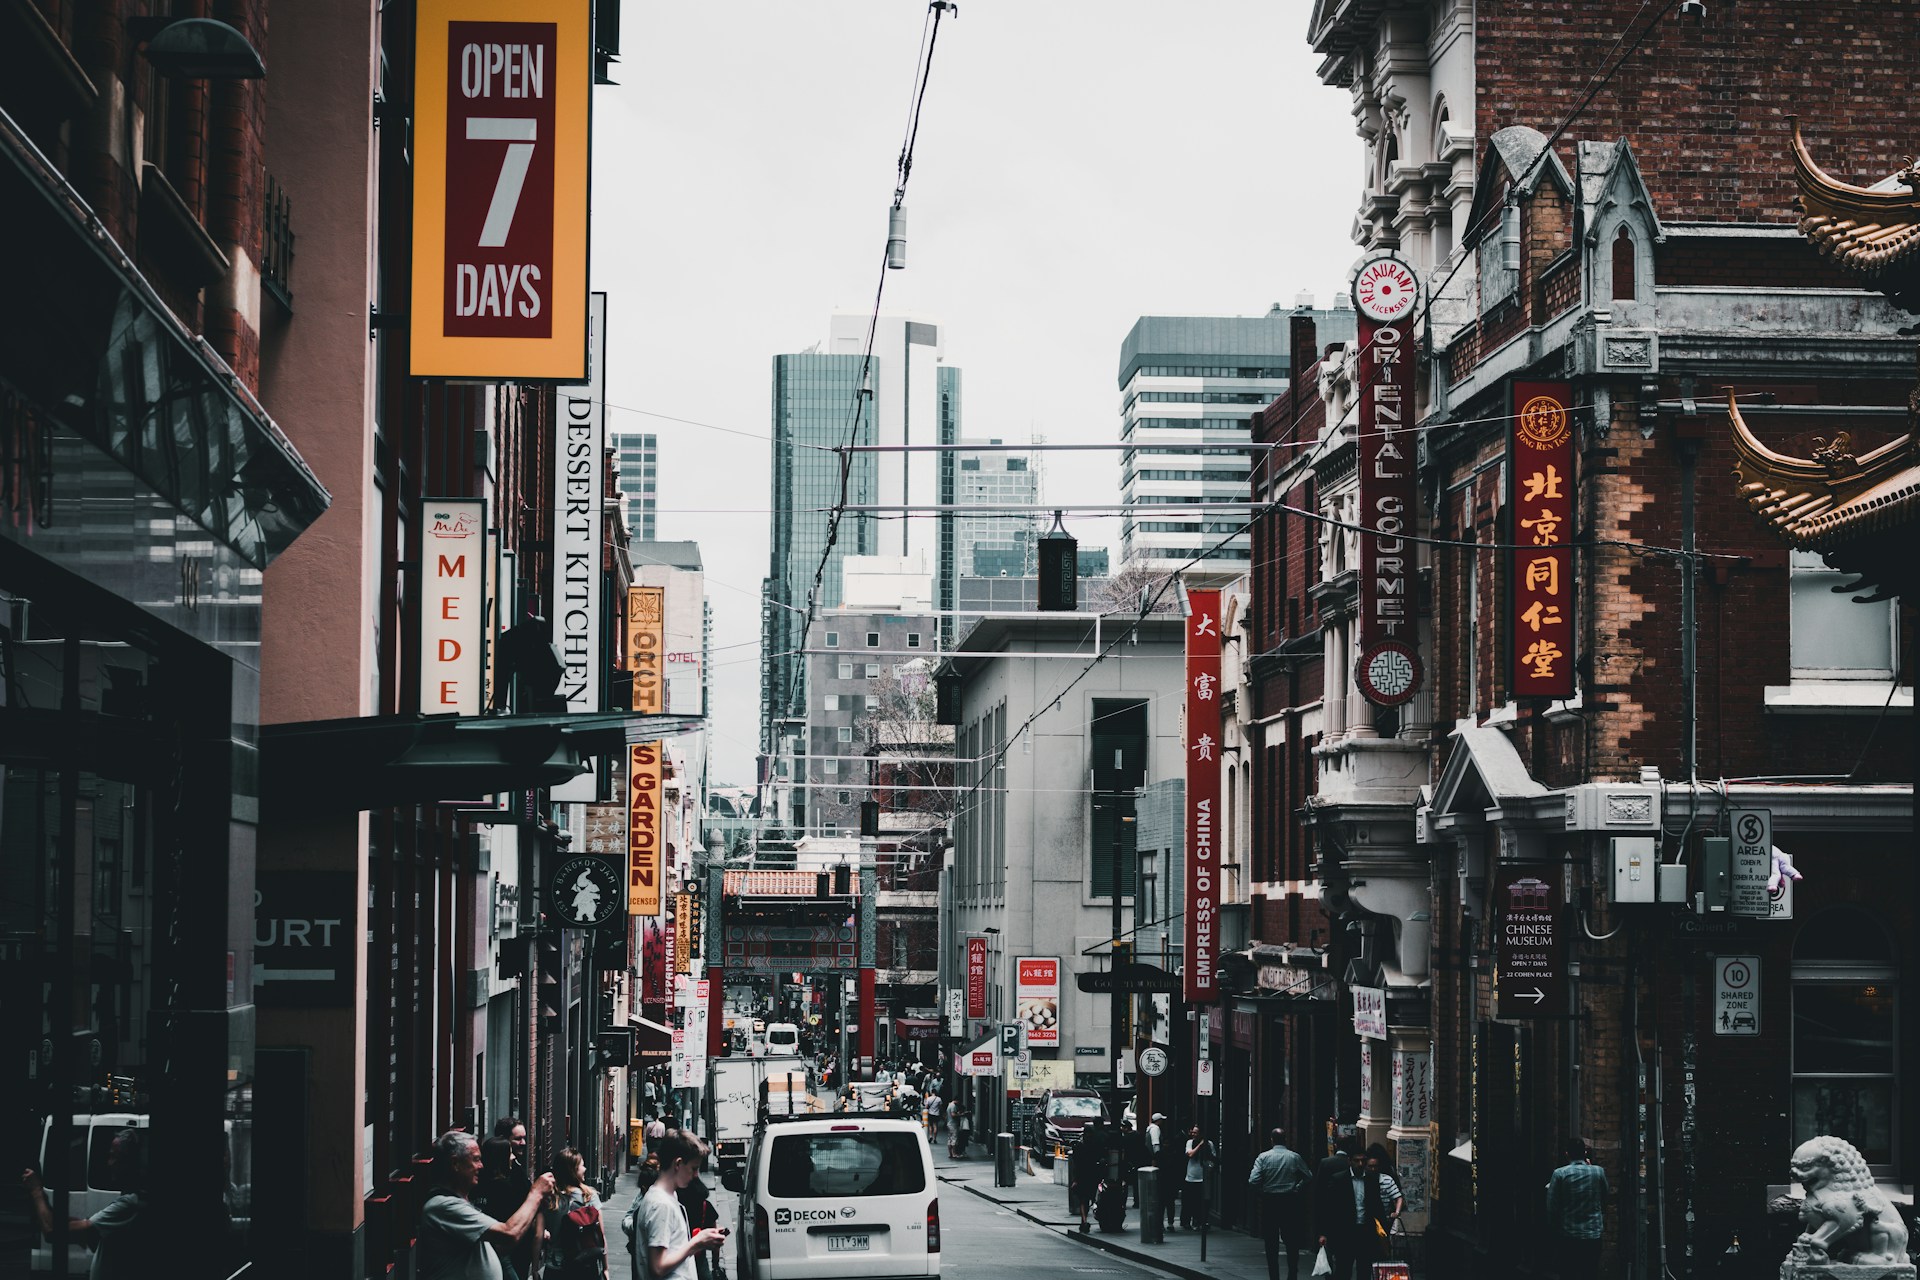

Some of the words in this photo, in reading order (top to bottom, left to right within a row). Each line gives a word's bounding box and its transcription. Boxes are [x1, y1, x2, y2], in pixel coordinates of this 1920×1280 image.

[461, 43, 544, 99] OPEN
[465, 117, 537, 248] 7
[455, 263, 542, 319] DAYS
[1359, 263, 1414, 304] RESTAURANT
[1371, 296, 1408, 314] LICENSED
[1372, 326, 1404, 479] ORIENTAL
[1516, 429, 1535, 449] TONG
[1536, 441, 1554, 451] REN
[1553, 430, 1572, 447] TANG
[565, 396, 592, 541] DESSERT
[1375, 496, 1405, 637] GOURMET
[1519, 463, 1564, 679] 北京同仁堂
[564, 551, 590, 705] KITCHEN
[667, 652, 697, 663] OTEL
[1191, 612, 1217, 762] 大富贵
[631, 772, 656, 887] GARDEN
[1196, 798, 1211, 861] CHINA
[1736, 845, 1766, 856] AREA
[556, 859, 598, 884] BANGKOK
[599, 866, 616, 884] JAM
[1196, 865, 1211, 892] OF
[599, 901, 615, 918] 2001
[629, 897, 657, 905] ICENSED
[1770, 904, 1785, 912] REA
[254, 918, 342, 947] URT
[1196, 897, 1211, 989] EMPRESS
[1505, 924, 1553, 935] CHINESE
[1505, 936, 1553, 946] MUSEUM
[664, 936, 675, 1009] TEPPANYAKI
[1731, 969, 1744, 982] 10
[970, 975, 978, 1008] STREET
[1720, 991, 1754, 1000] SHARED
[1726, 1001, 1748, 1009] ZONE
[1003, 1026, 1017, 1043] P
[1405, 1057, 1415, 1122] SHANGHAI
[1418, 1061, 1428, 1119] VILLAGE
[794, 1210, 836, 1220] DECON
